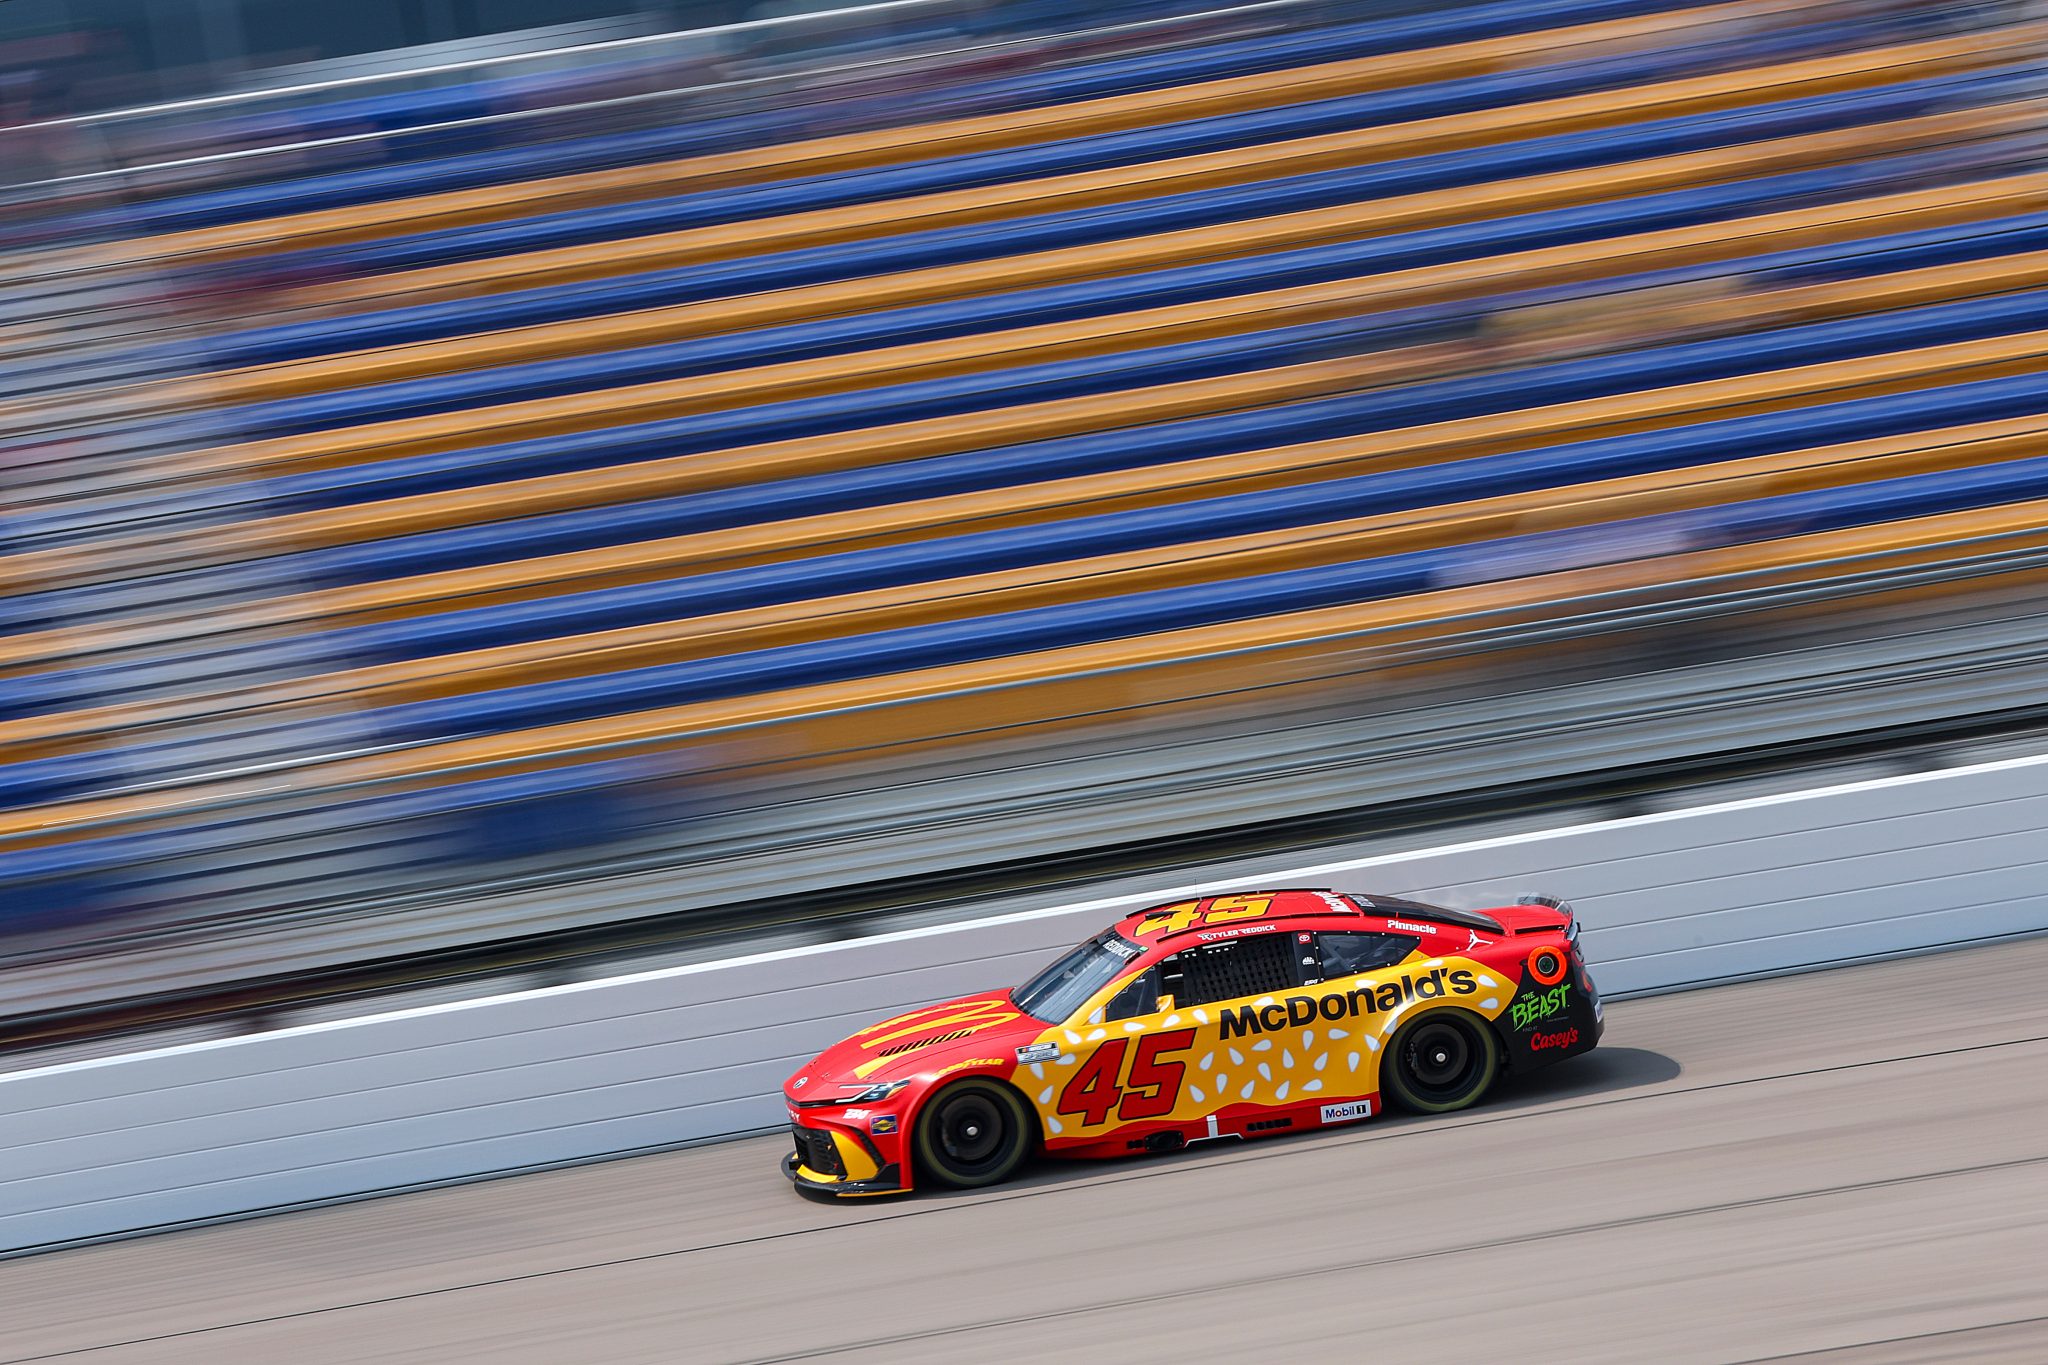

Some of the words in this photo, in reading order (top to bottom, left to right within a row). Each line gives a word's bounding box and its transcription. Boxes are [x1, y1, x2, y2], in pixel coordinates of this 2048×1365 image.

[1134, 893, 1279, 937] 45
[1387, 919, 1437, 934] Pinnacle
[1211, 929, 1239, 939] TYLER
[1239, 924, 1277, 935] REDDICK
[1219, 967, 1478, 1041] McDonald's
[1508, 983, 1572, 1033] BEAST
[1521, 991, 1536, 1002] THE
[1530, 1027, 1579, 1052] Casey's
[1057, 1027, 1197, 1127] 45
[1325, 1106, 1355, 1119] Mobil
